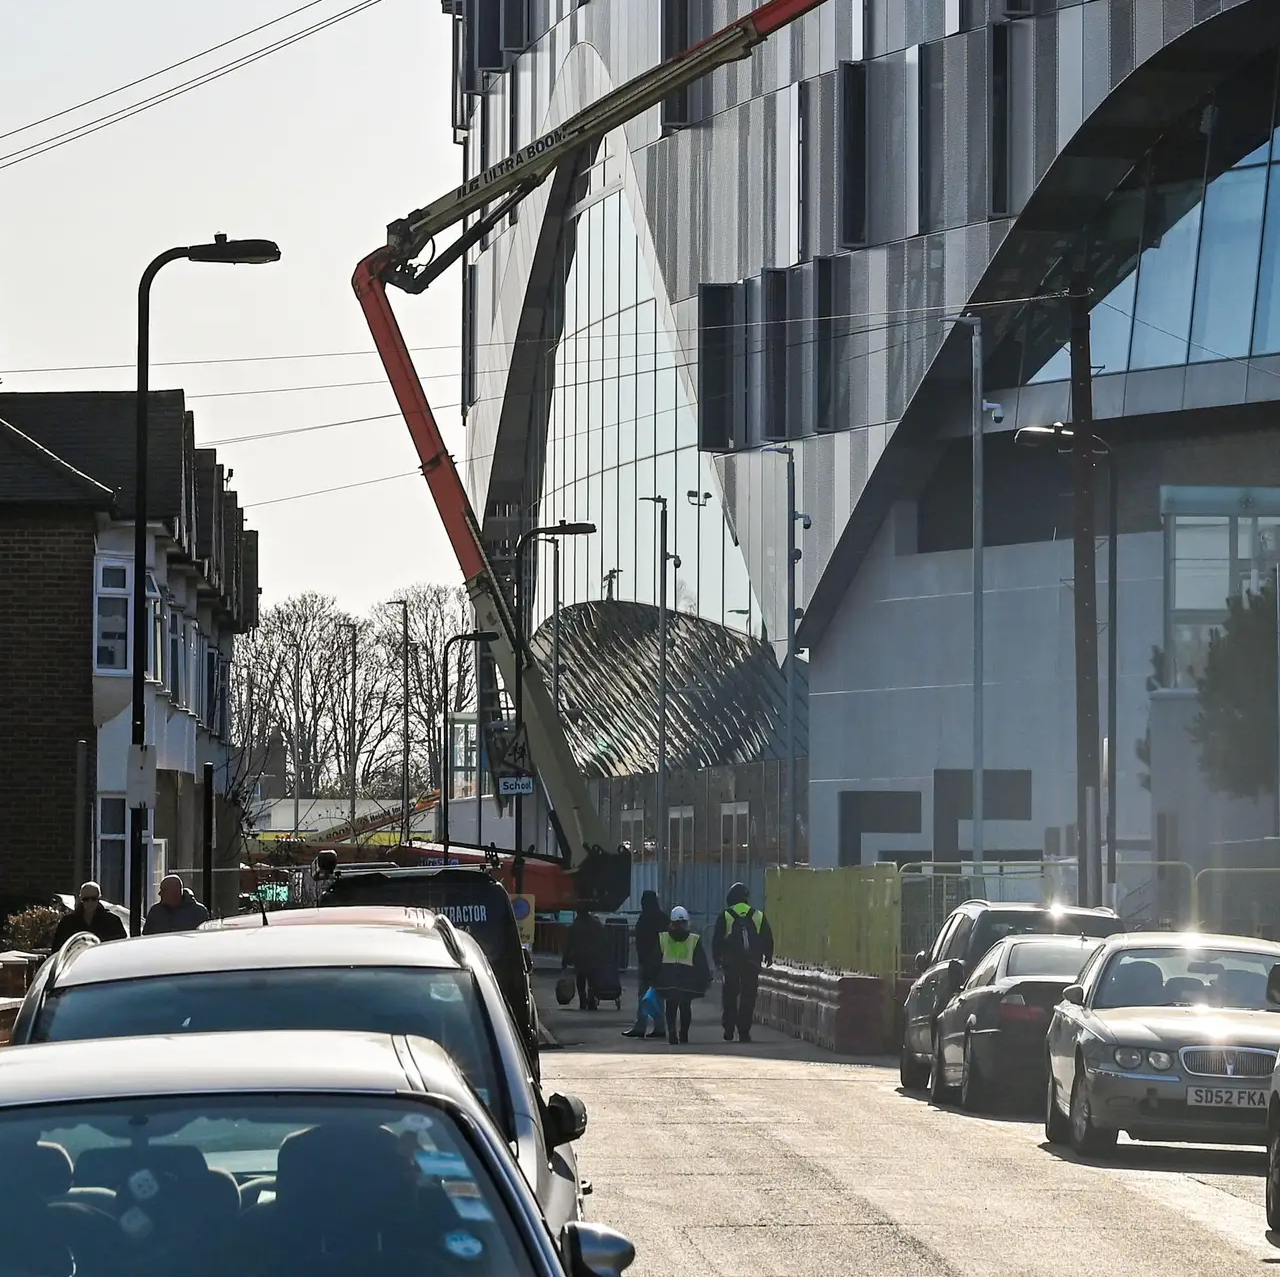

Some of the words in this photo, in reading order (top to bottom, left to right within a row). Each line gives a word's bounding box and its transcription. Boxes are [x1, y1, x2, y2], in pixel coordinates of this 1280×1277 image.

[483, 153, 524, 184] ULTRA
[502, 780, 532, 794] School
[369, 809, 391, 822] Height
[392, 805, 402, 814] for
[430, 904, 488, 923] TRACTOR
[1194, 1089, 1234, 1105] SD52
[1237, 1090, 1266, 1106] FKA
